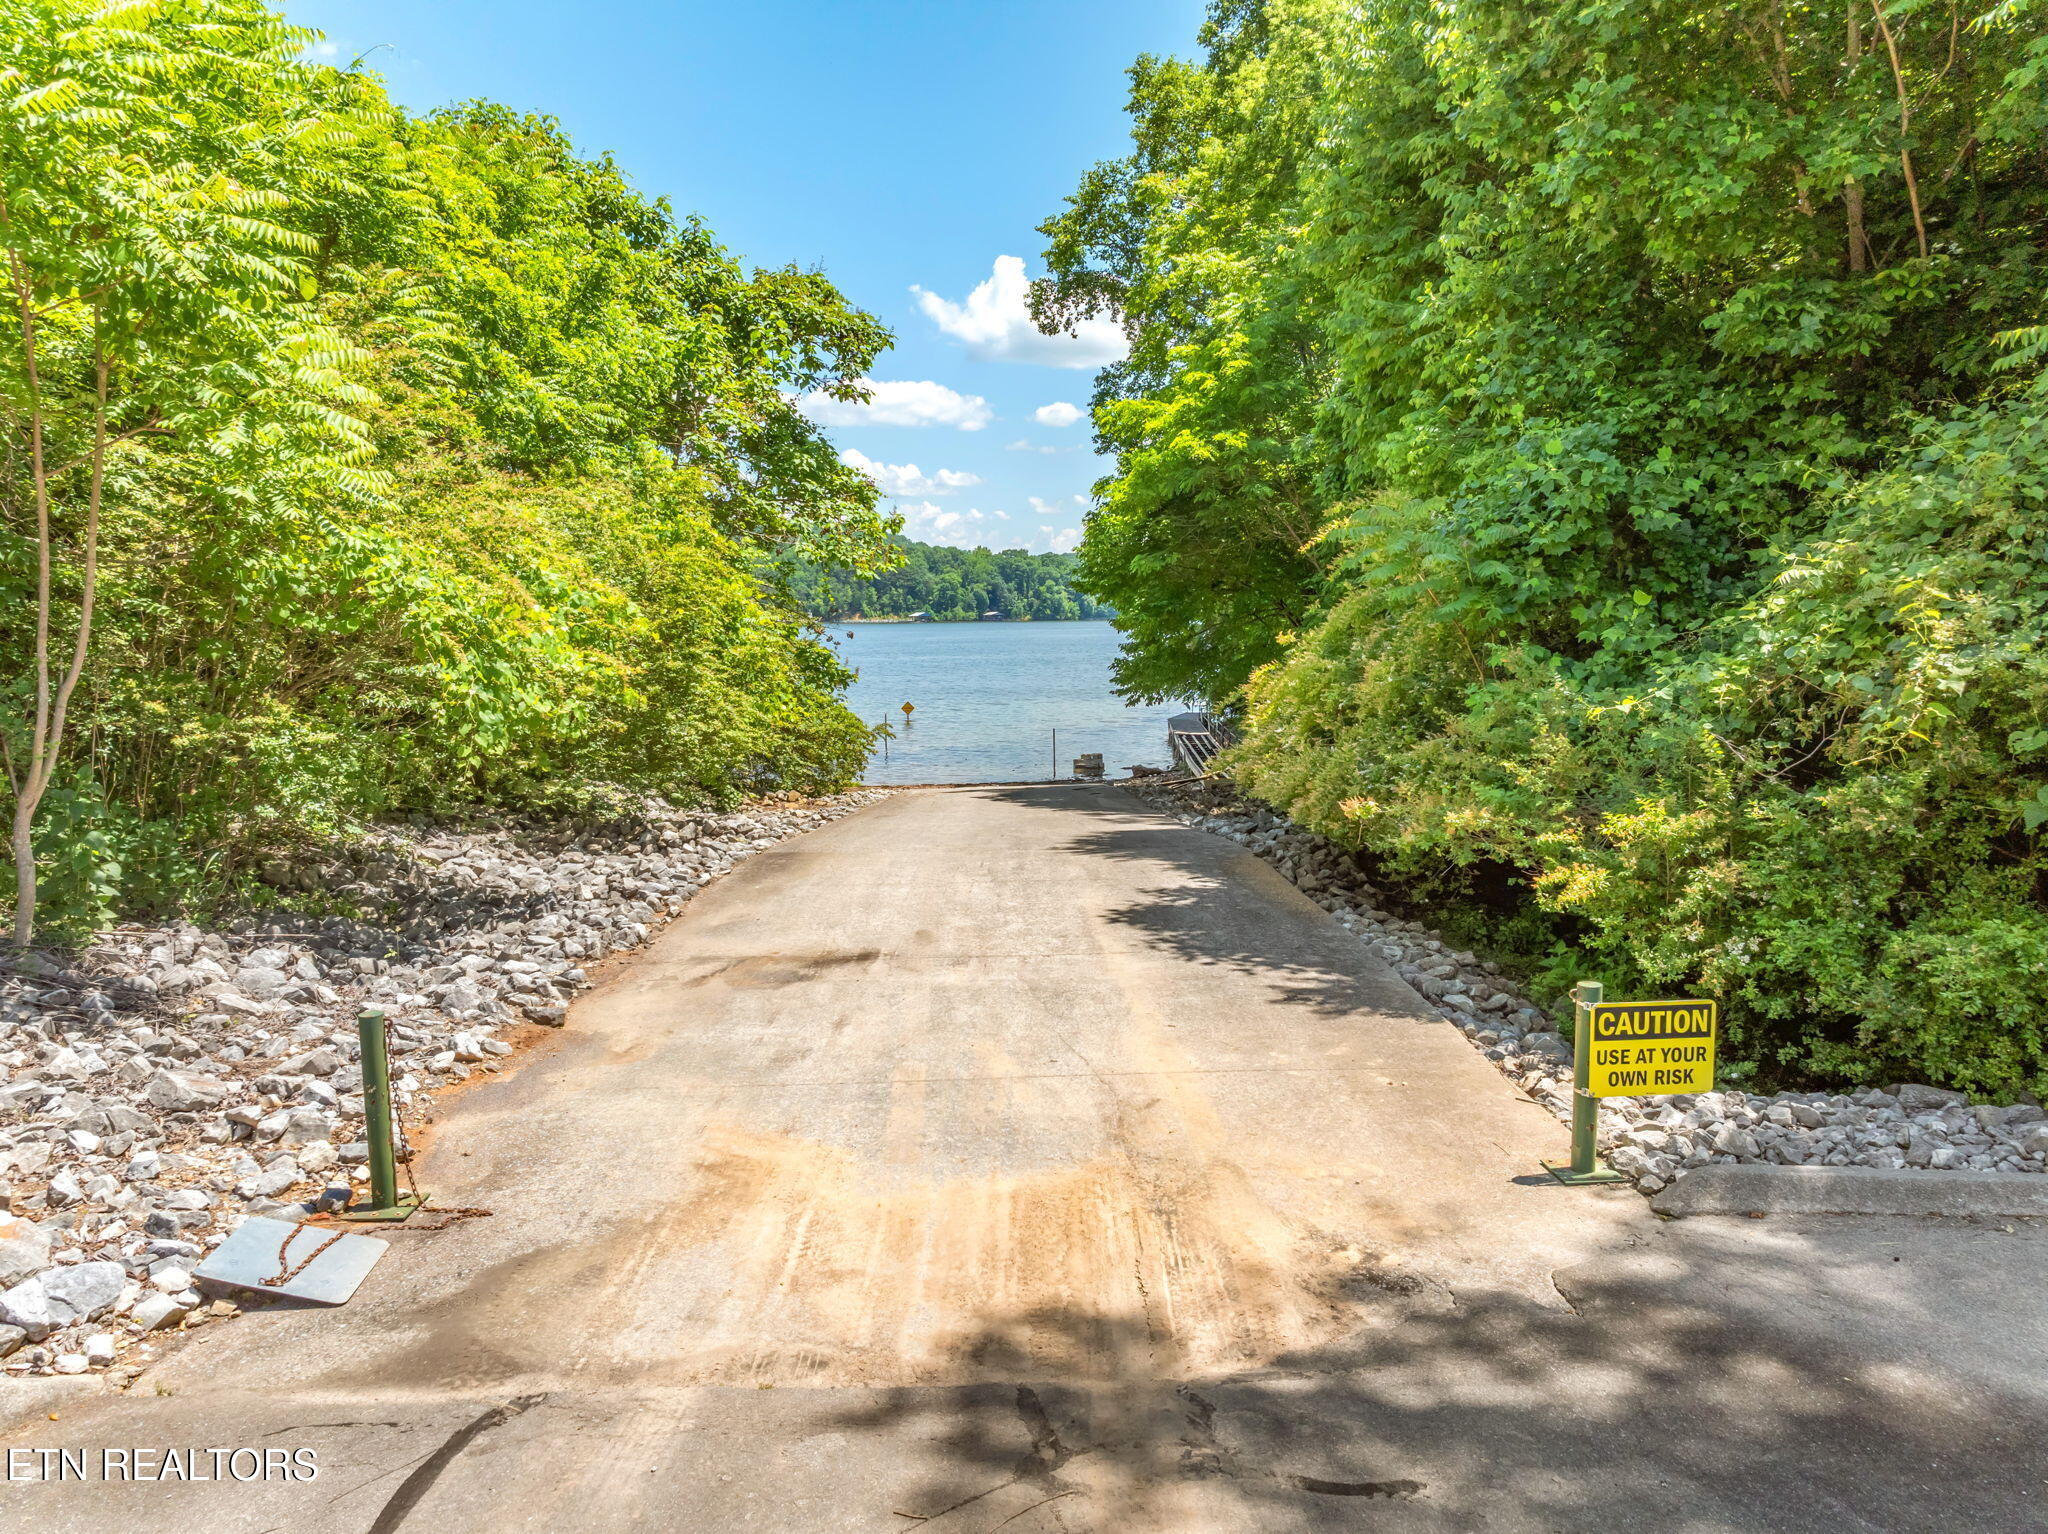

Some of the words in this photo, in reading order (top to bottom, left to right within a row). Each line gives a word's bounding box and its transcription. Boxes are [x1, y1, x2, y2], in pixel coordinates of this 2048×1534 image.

[1598, 1009, 1708, 1036] CAUTION
[1596, 1049, 1630, 1065] USE
[1635, 1048, 1656, 1064] AT
[1661, 1046, 1707, 1063] YOUR
[1608, 1070, 1647, 1087] OWN
[1654, 1068, 1694, 1085] RISK
